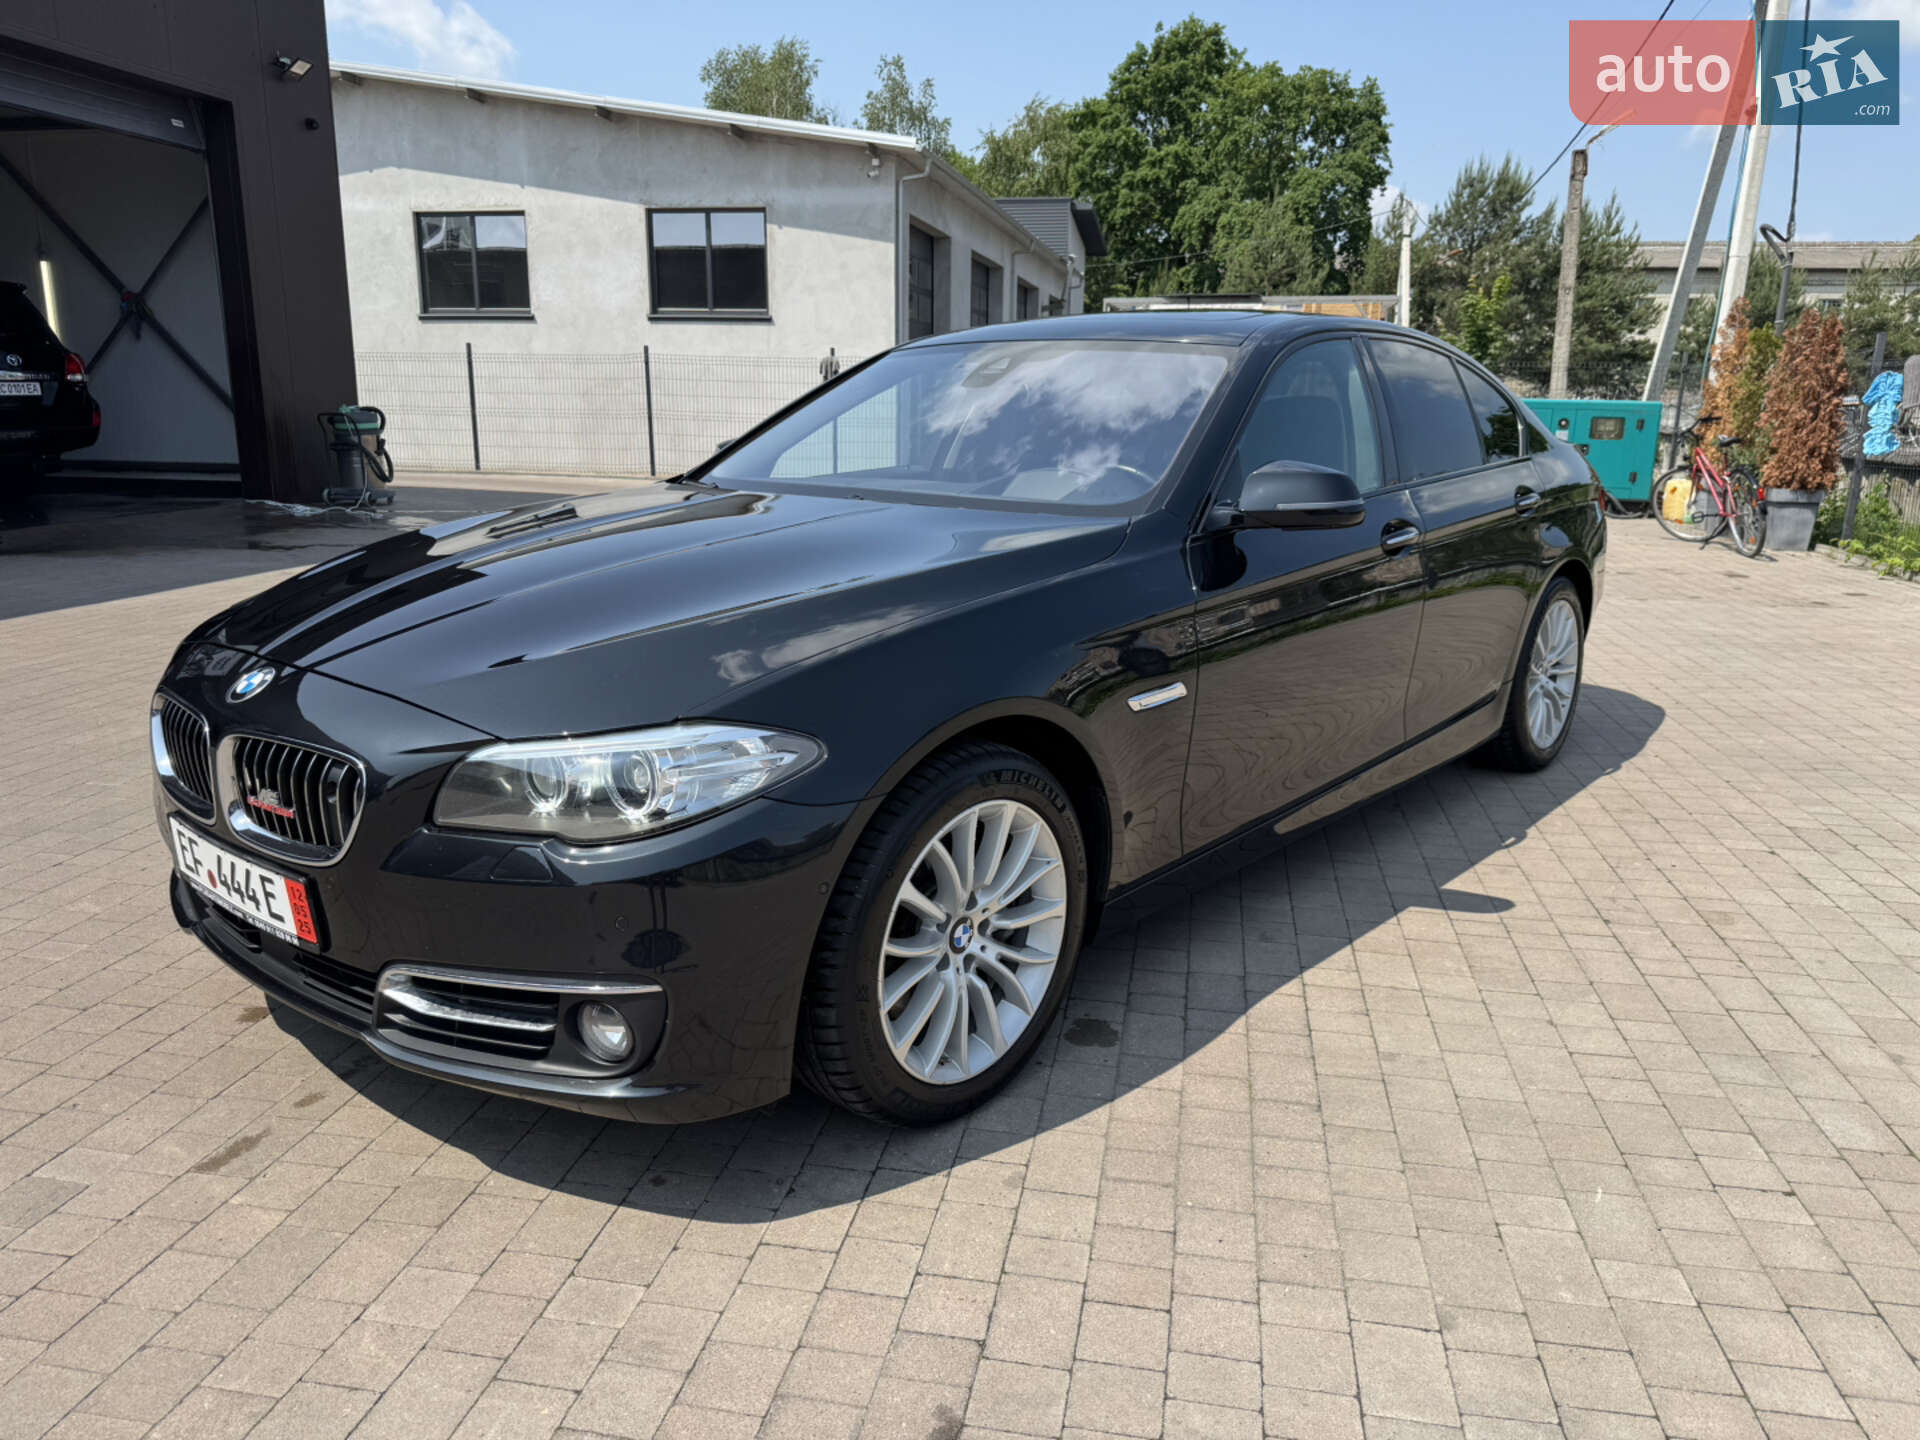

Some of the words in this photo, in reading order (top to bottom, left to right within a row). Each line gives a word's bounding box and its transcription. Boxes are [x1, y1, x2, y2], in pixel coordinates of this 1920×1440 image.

[999, 770, 1065, 811] MICHELIN
[177, 829, 203, 877] EF
[297, 919, 311, 934] 25
